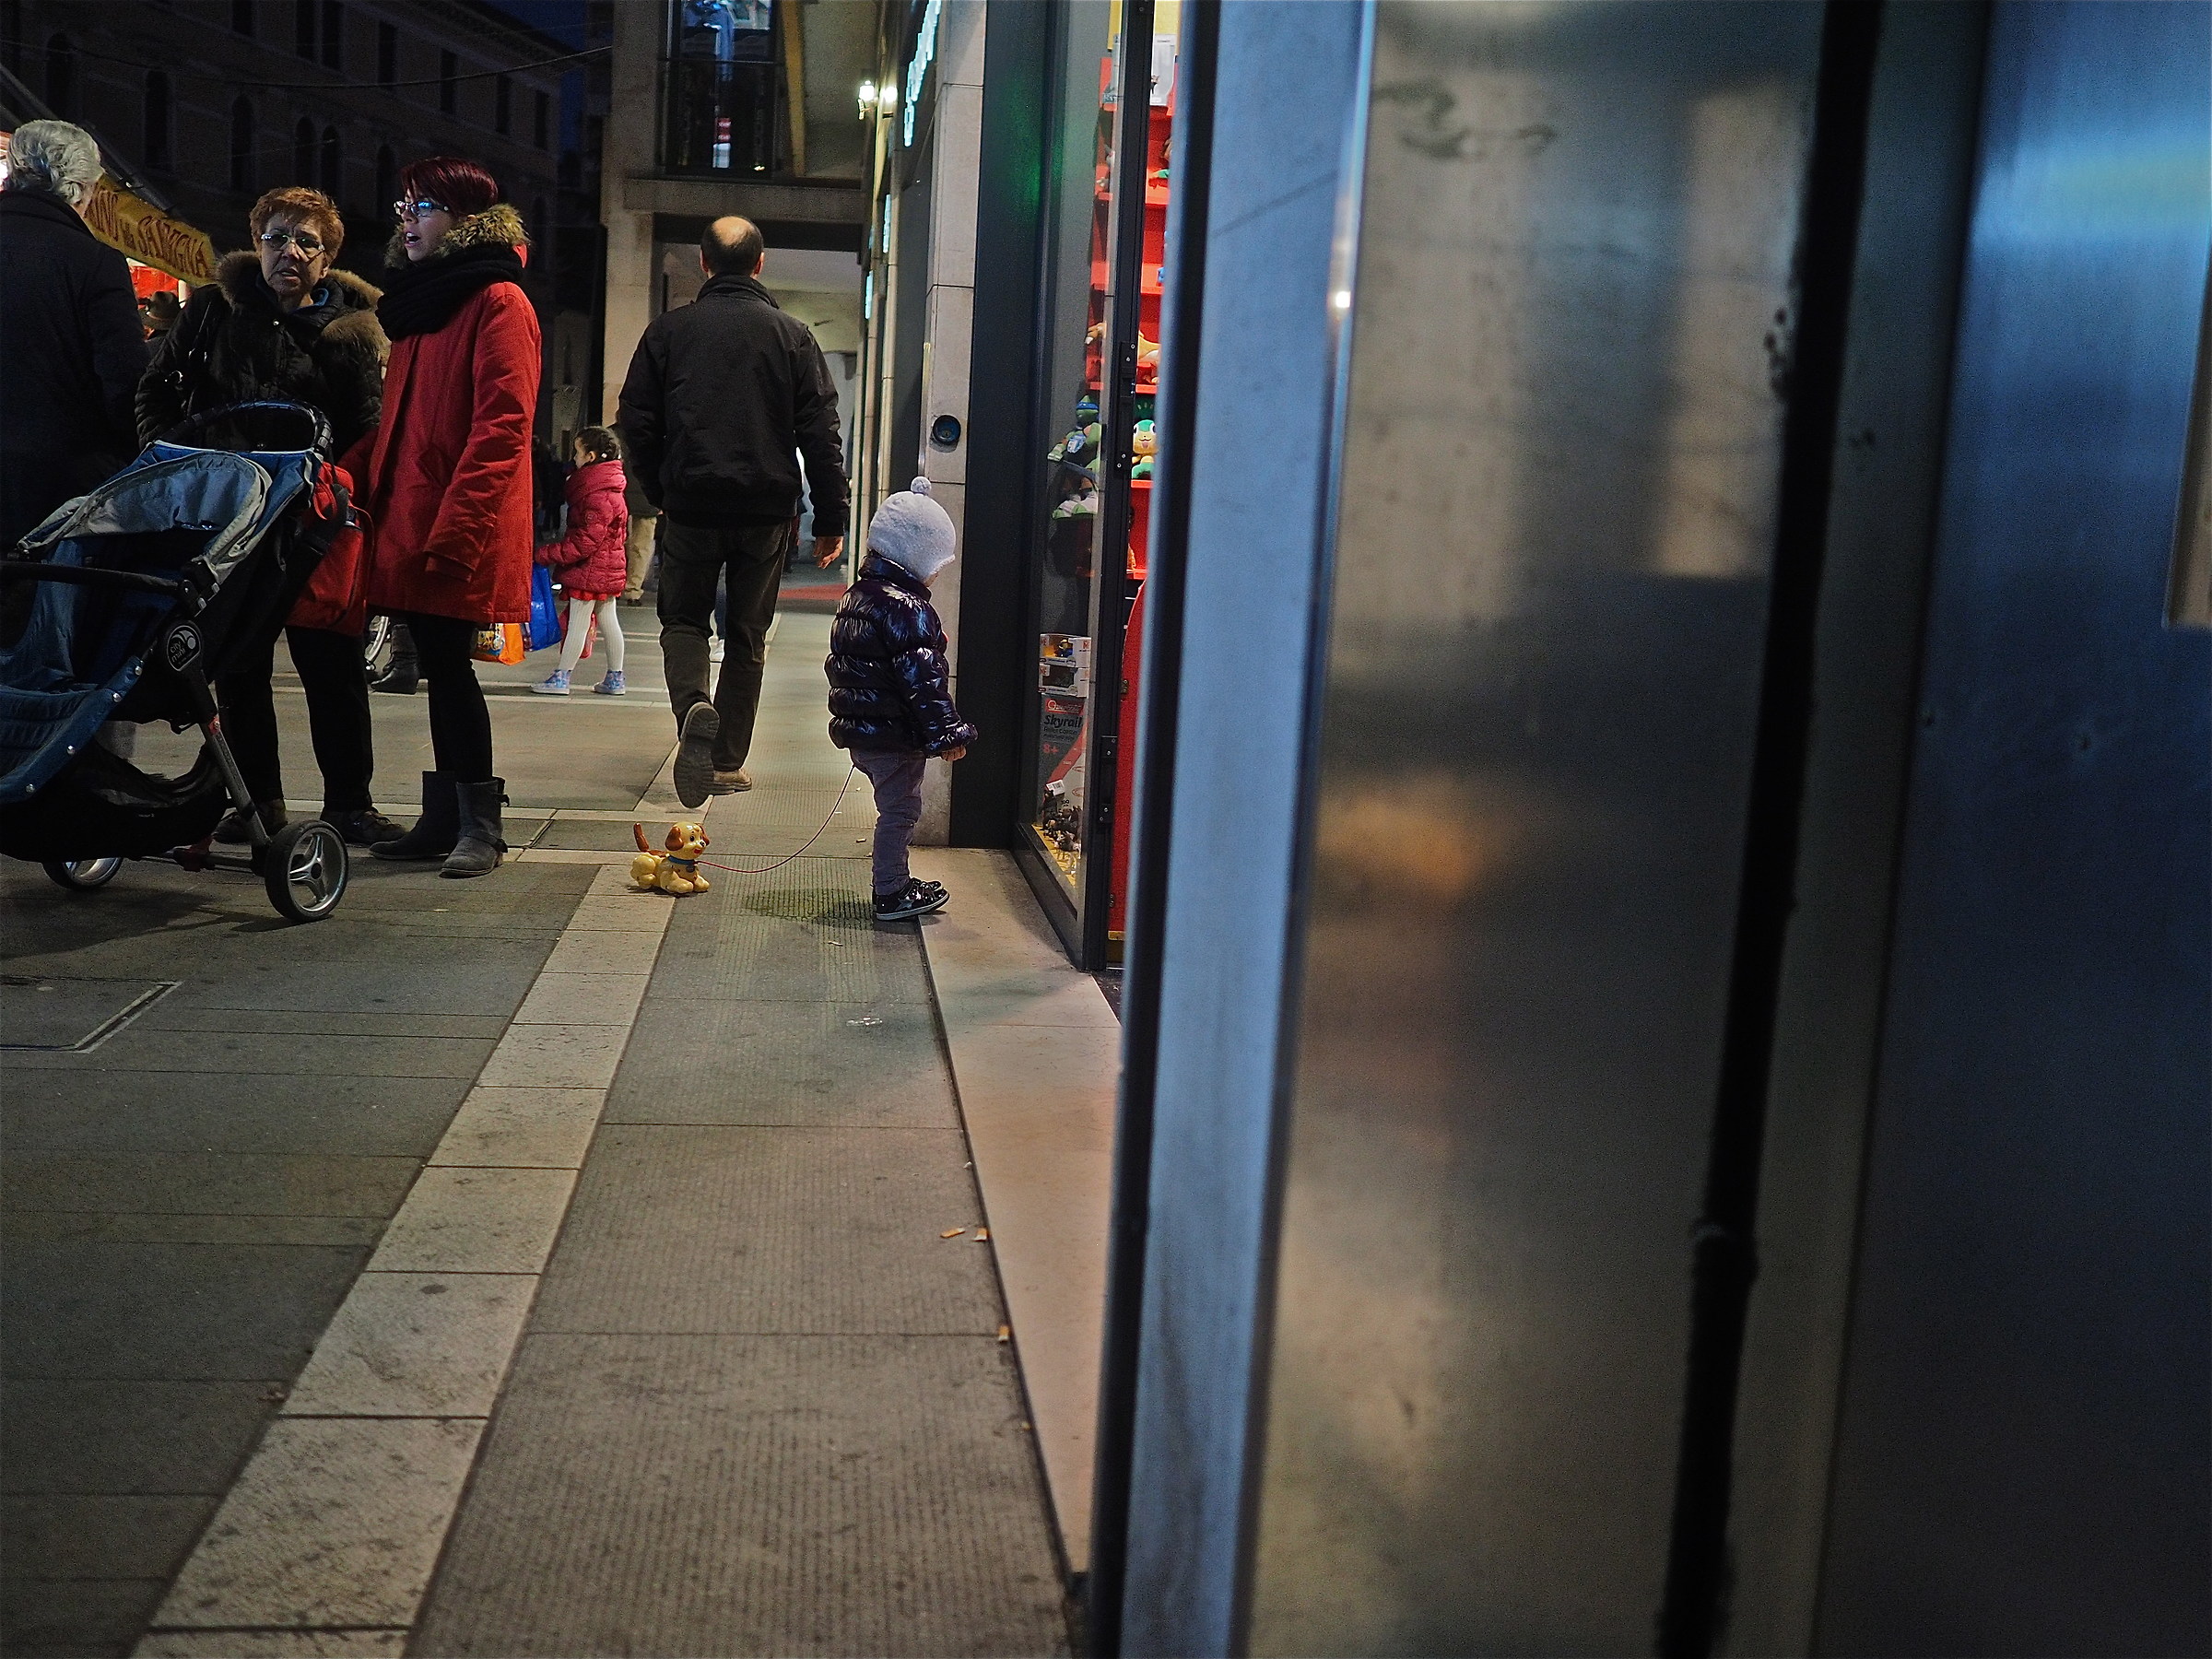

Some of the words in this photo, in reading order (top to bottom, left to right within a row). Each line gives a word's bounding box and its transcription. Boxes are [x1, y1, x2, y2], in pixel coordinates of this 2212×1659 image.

[171, 641, 182, 653] city
[171, 647, 186, 663] mini
[1044, 713, 1083, 728] Skyrail
